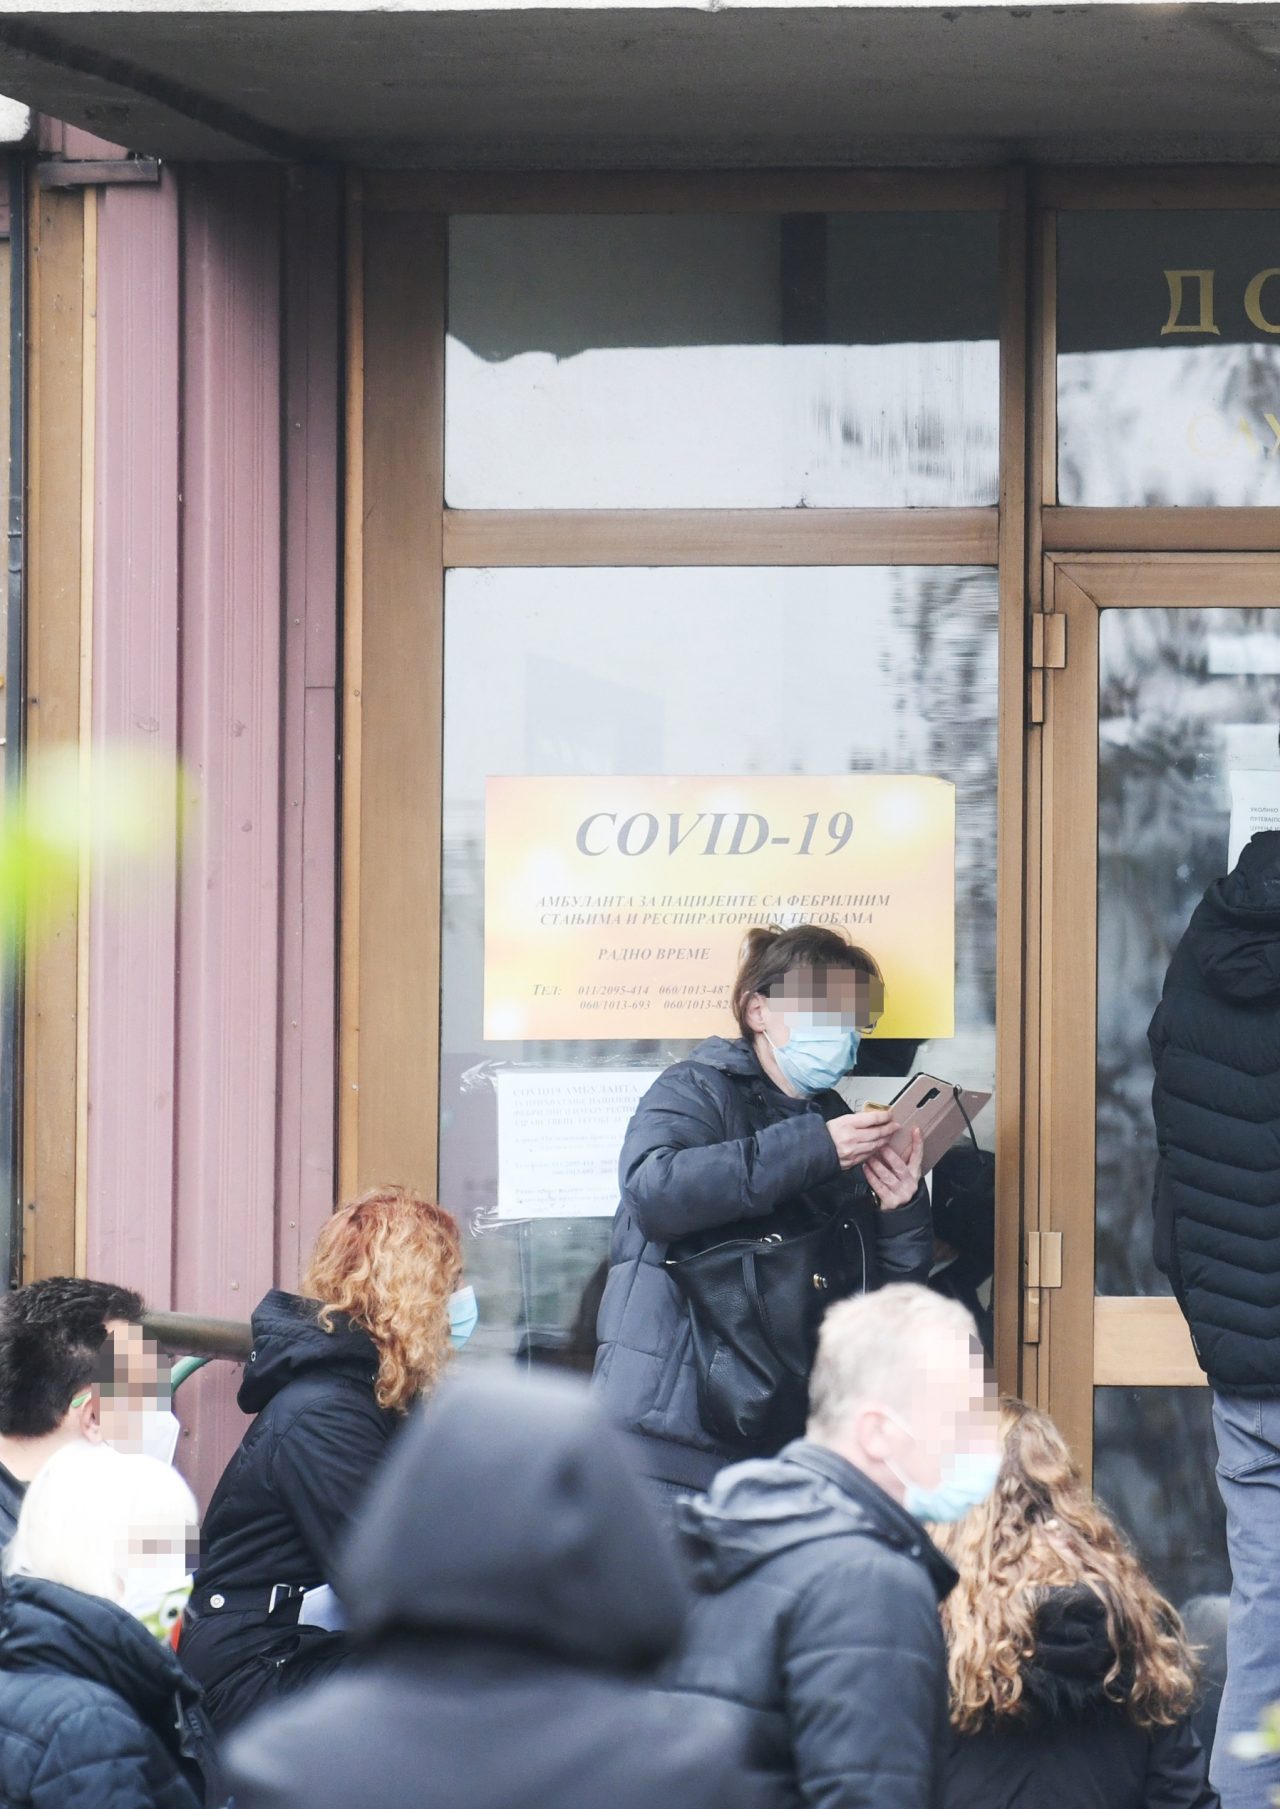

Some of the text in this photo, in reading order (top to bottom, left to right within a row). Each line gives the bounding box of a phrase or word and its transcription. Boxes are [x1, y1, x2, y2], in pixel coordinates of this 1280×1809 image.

[576, 811, 854, 856] COVID-19
[537, 894, 890, 909] АМБУЛАНТА ЗА ПАЦИЈЕНТЕ СА ФЕБРИЛНИМ
[540, 911, 874, 926] СТАЊИМА И РЕСПИРАТОРНИМ ТЕГОБАМА
[598, 948, 712, 962] РАДНО ВРЕМЕ
[578, 985, 650, 996] 011/2095-414
